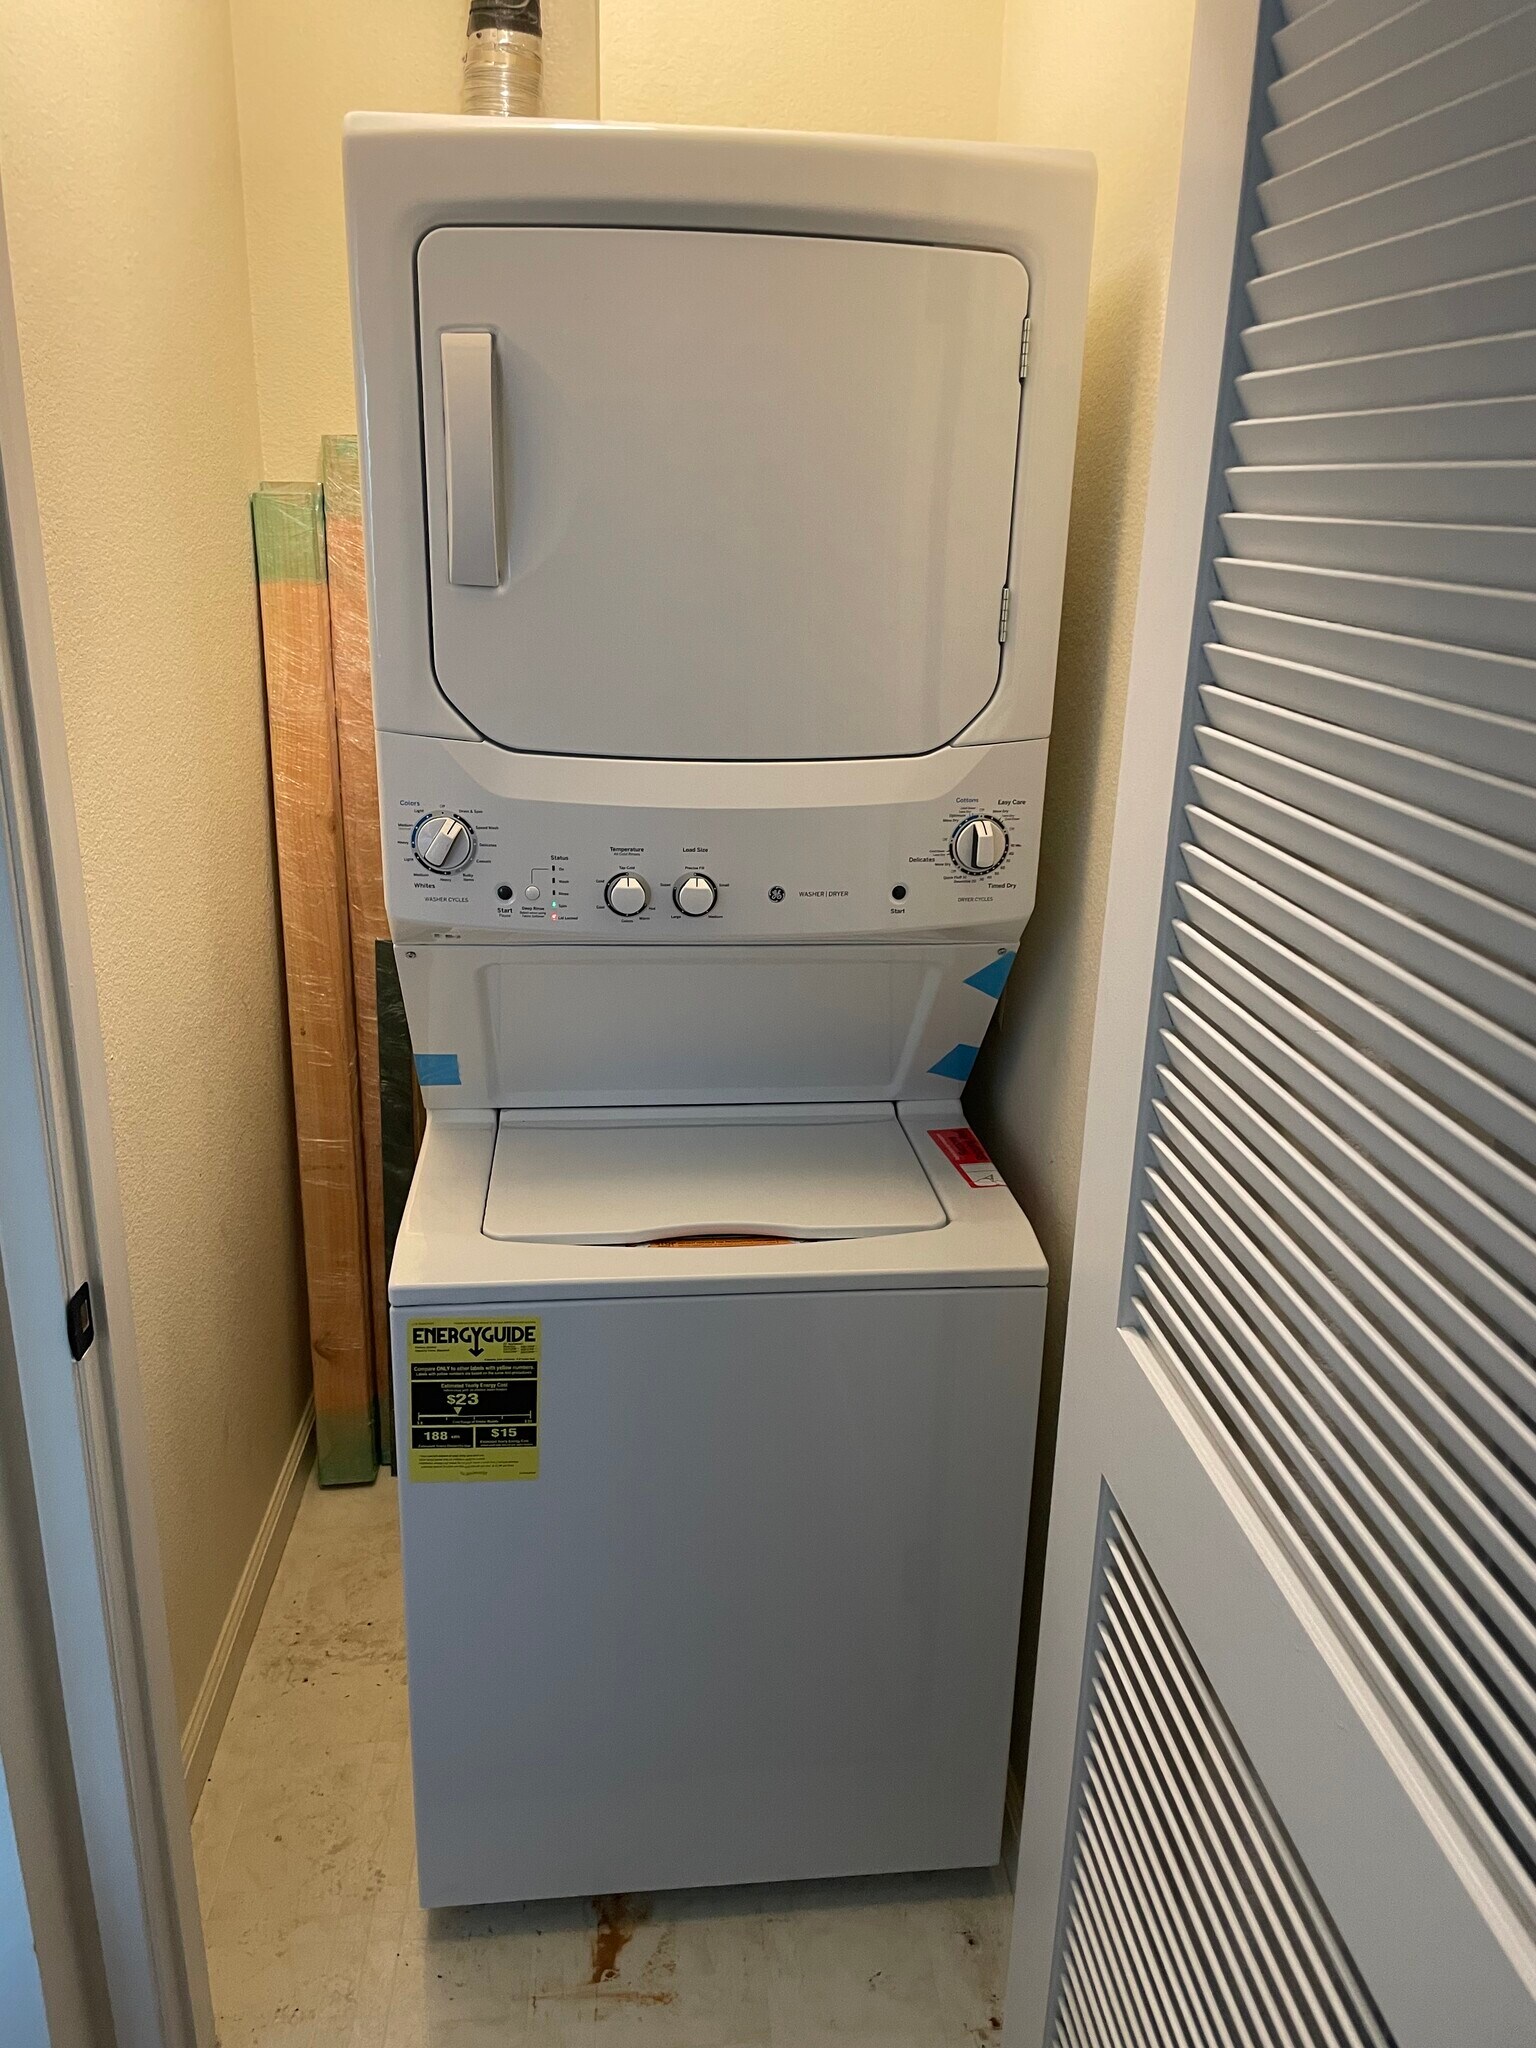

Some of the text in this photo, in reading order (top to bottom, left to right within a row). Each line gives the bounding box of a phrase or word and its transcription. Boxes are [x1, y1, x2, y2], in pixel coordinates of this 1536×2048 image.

[412, 1325, 536, 1344] ENERGYGUIDE
[446, 1393, 479, 1406] $23
[423, 1431, 448, 1441] 188
[491, 1428, 517, 1438] $15
